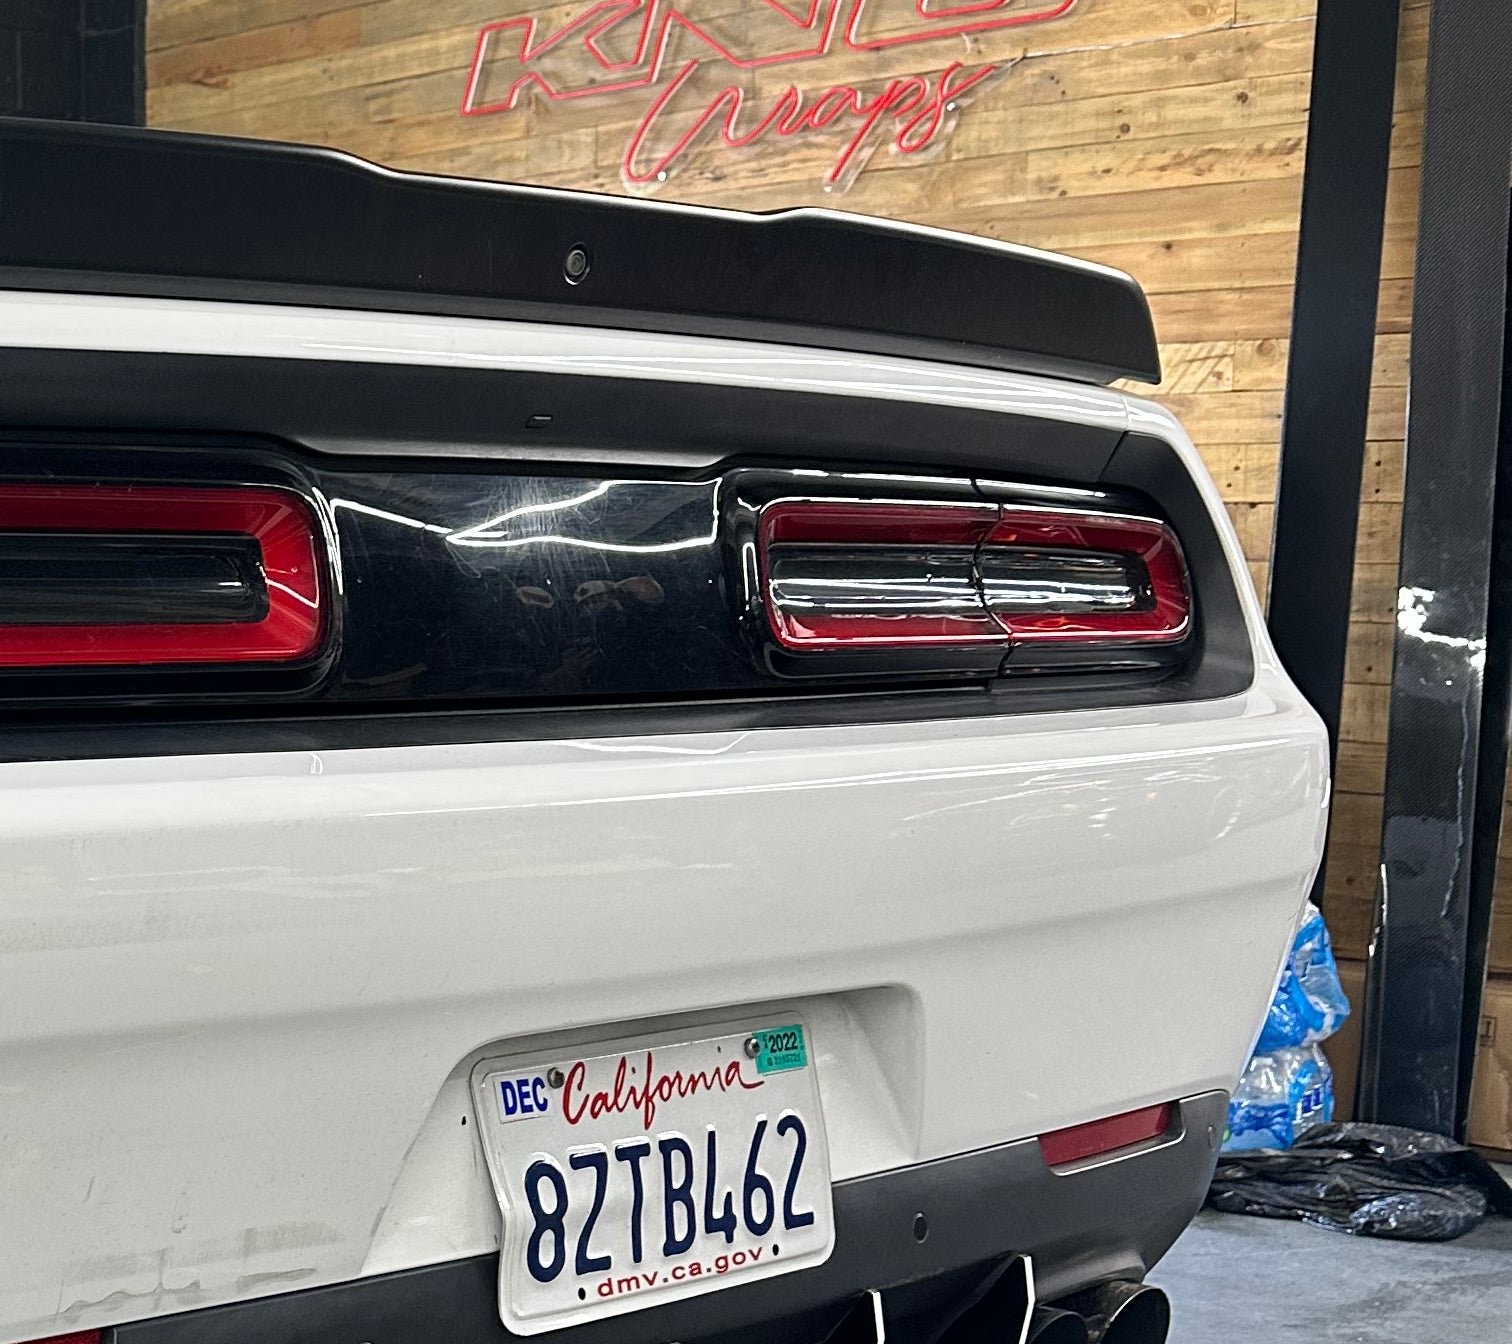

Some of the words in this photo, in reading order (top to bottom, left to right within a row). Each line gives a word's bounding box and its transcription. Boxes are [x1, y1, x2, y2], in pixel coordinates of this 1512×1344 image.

[768, 1031, 799, 1054] 2022
[501, 1077, 549, 1117] DEC
[561, 1050, 765, 1130] California
[524, 1114, 815, 1284] 8ZTB462
[596, 1245, 764, 1298] dmv.ca.gov
